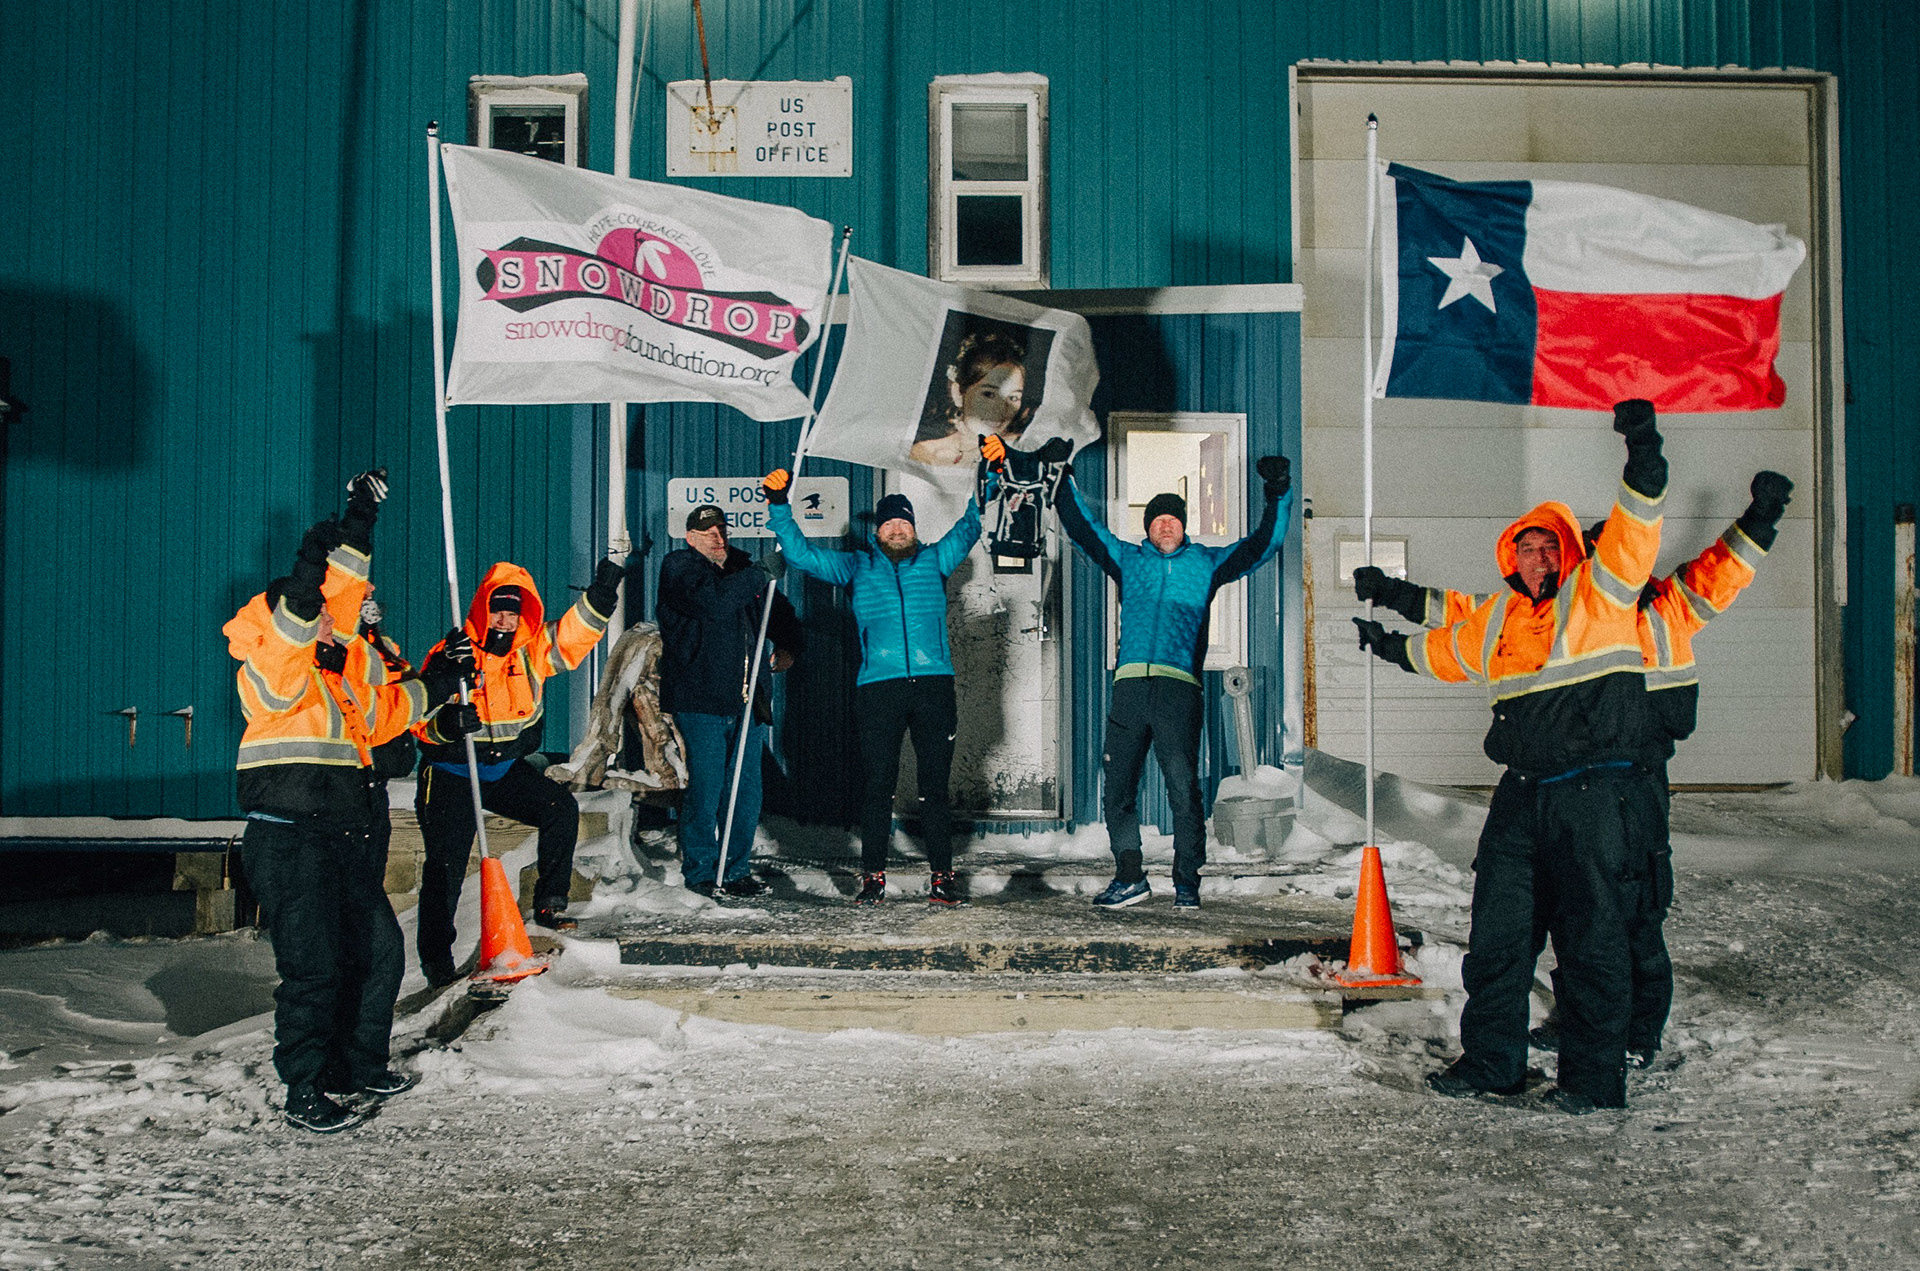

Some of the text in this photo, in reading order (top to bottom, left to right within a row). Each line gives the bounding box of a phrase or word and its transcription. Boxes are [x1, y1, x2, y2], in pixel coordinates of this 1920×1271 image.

[780, 97, 804, 114] US
[767, 121, 817, 138] POST
[755, 146, 829, 163] OFFICE
[501, 257, 795, 339] SNOWDROP
[685, 486, 767, 504] U.S. POS
[723, 511, 764, 529] FICE
